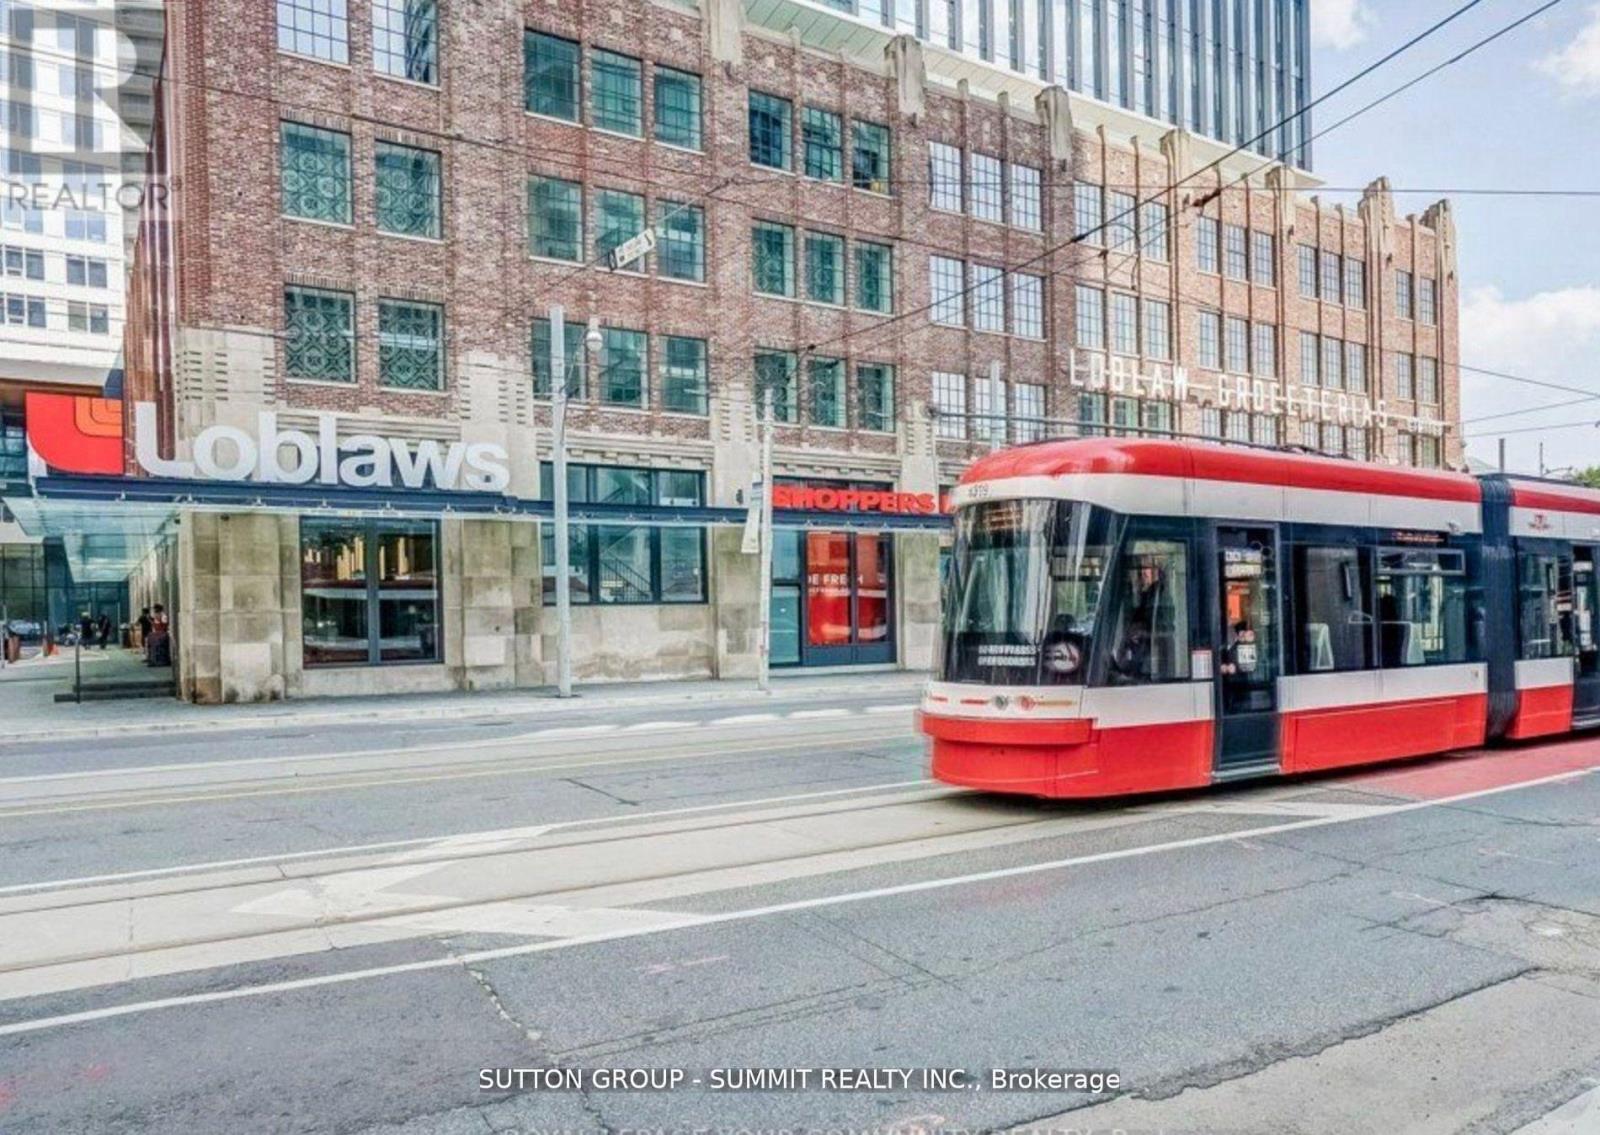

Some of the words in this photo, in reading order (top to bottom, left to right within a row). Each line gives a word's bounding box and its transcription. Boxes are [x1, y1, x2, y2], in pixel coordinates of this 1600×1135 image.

[1070, 348, 1188, 401] LOBLAW
[134, 401, 511, 491] Loblaws
[773, 485, 936, 514] SHOPPERS
[823, 574, 864, 585] FREH
